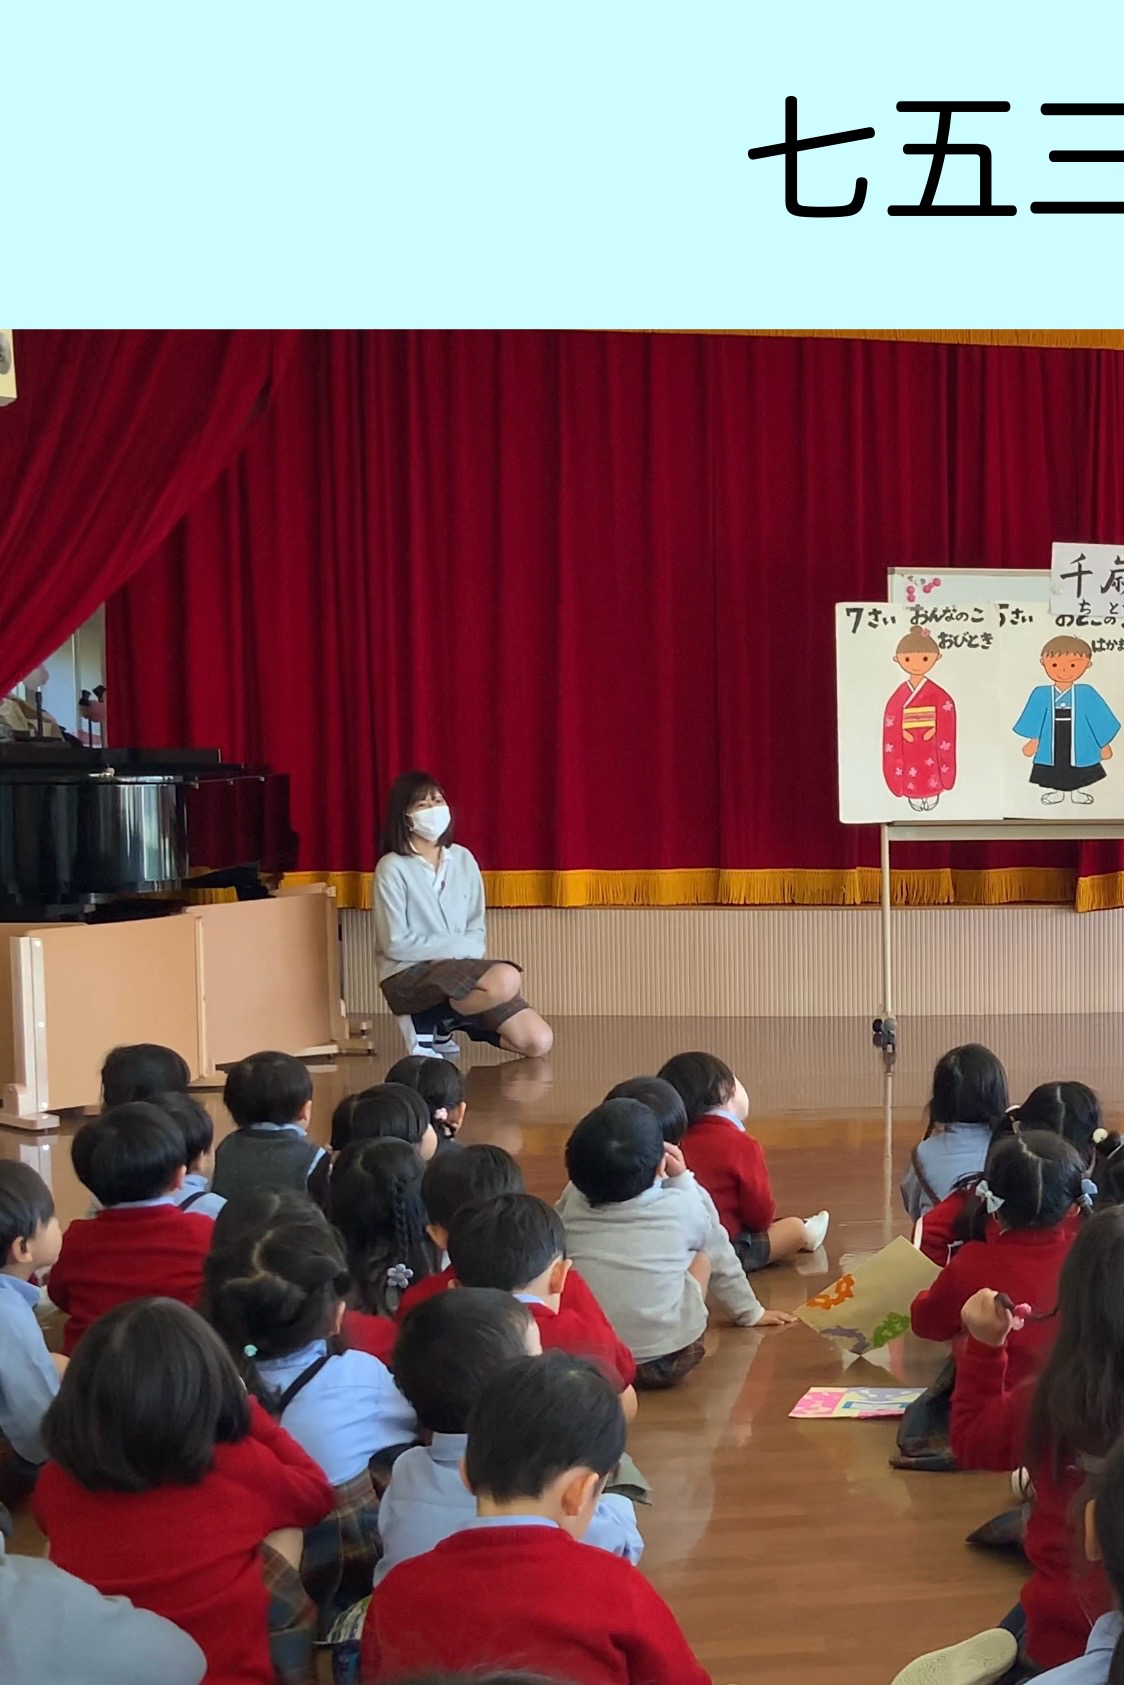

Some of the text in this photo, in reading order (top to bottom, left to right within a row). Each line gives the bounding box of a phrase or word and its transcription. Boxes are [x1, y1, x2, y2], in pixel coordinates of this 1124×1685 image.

[845, 603, 985, 634] 7さい おんなのこ
[937, 631, 994, 650] おびとき
